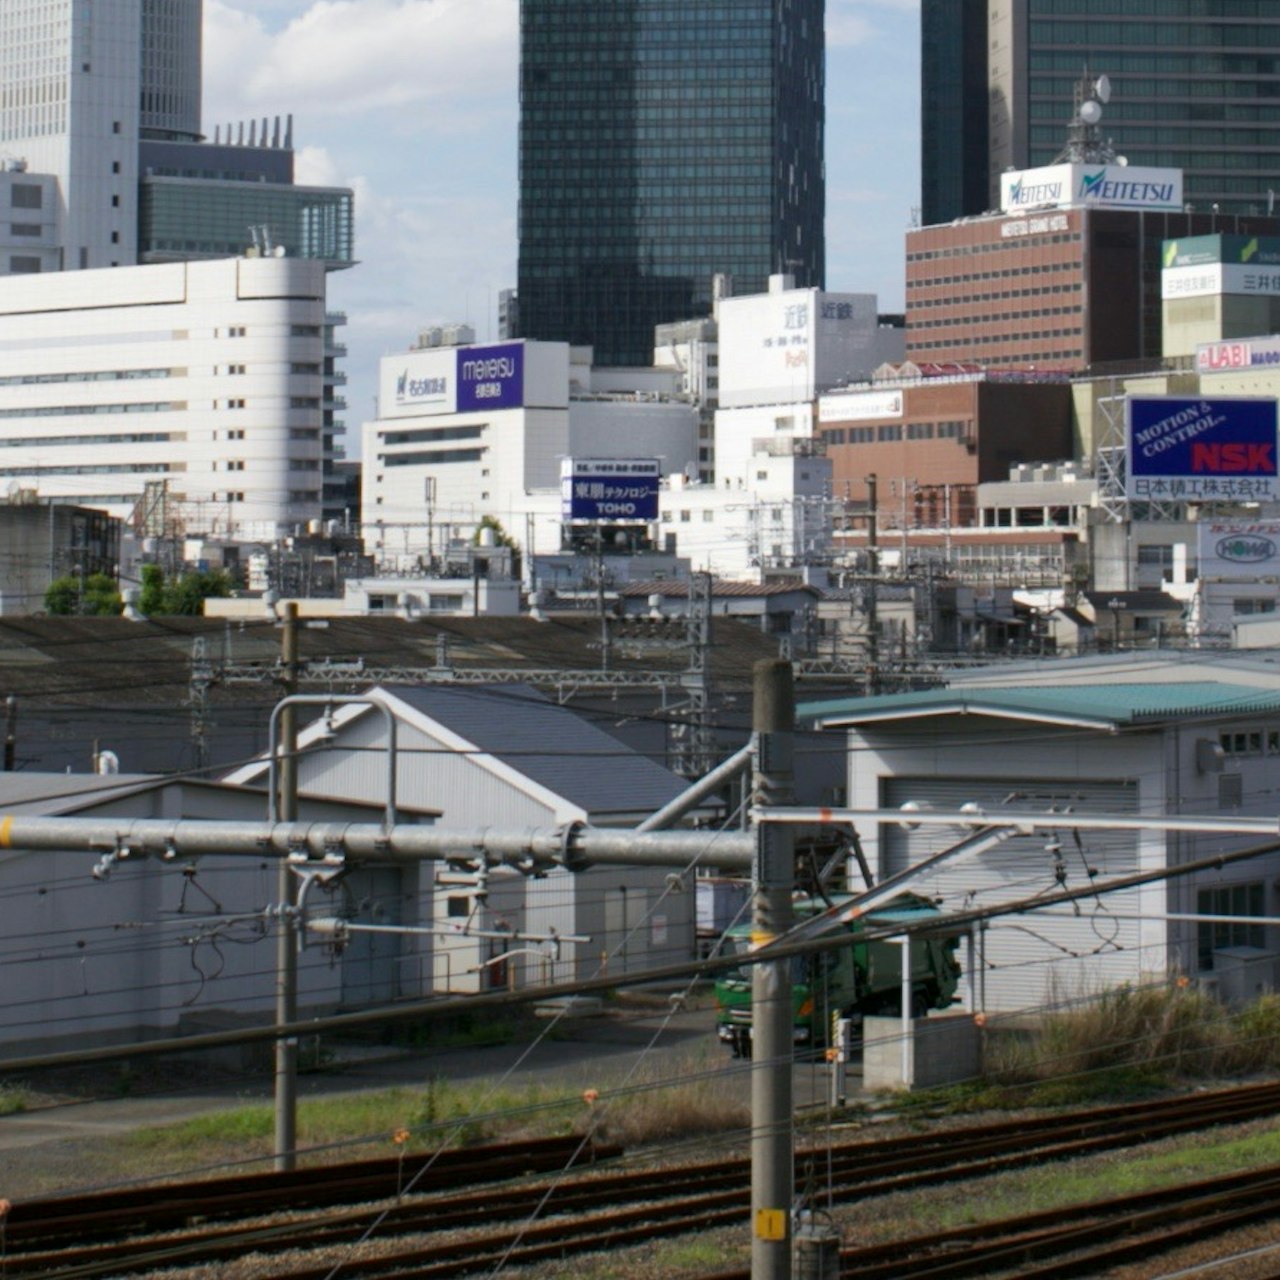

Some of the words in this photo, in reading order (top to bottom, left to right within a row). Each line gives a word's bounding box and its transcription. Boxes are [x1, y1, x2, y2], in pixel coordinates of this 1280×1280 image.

[1007, 174, 1062, 204] MEITETSU
[1078, 167, 1173, 201] MEITETSU
[1167, 275, 1217, 294] 三井住友銀行
[822, 302, 853, 320] 近鉄
[1135, 405, 1200, 446] MOTION
[1200, 400, 1213, 414] &
[1191, 442, 1274, 472] NSK
[1135, 479, 1272, 496] 日本精工株式会社
[596, 502, 637, 515] TOHO
